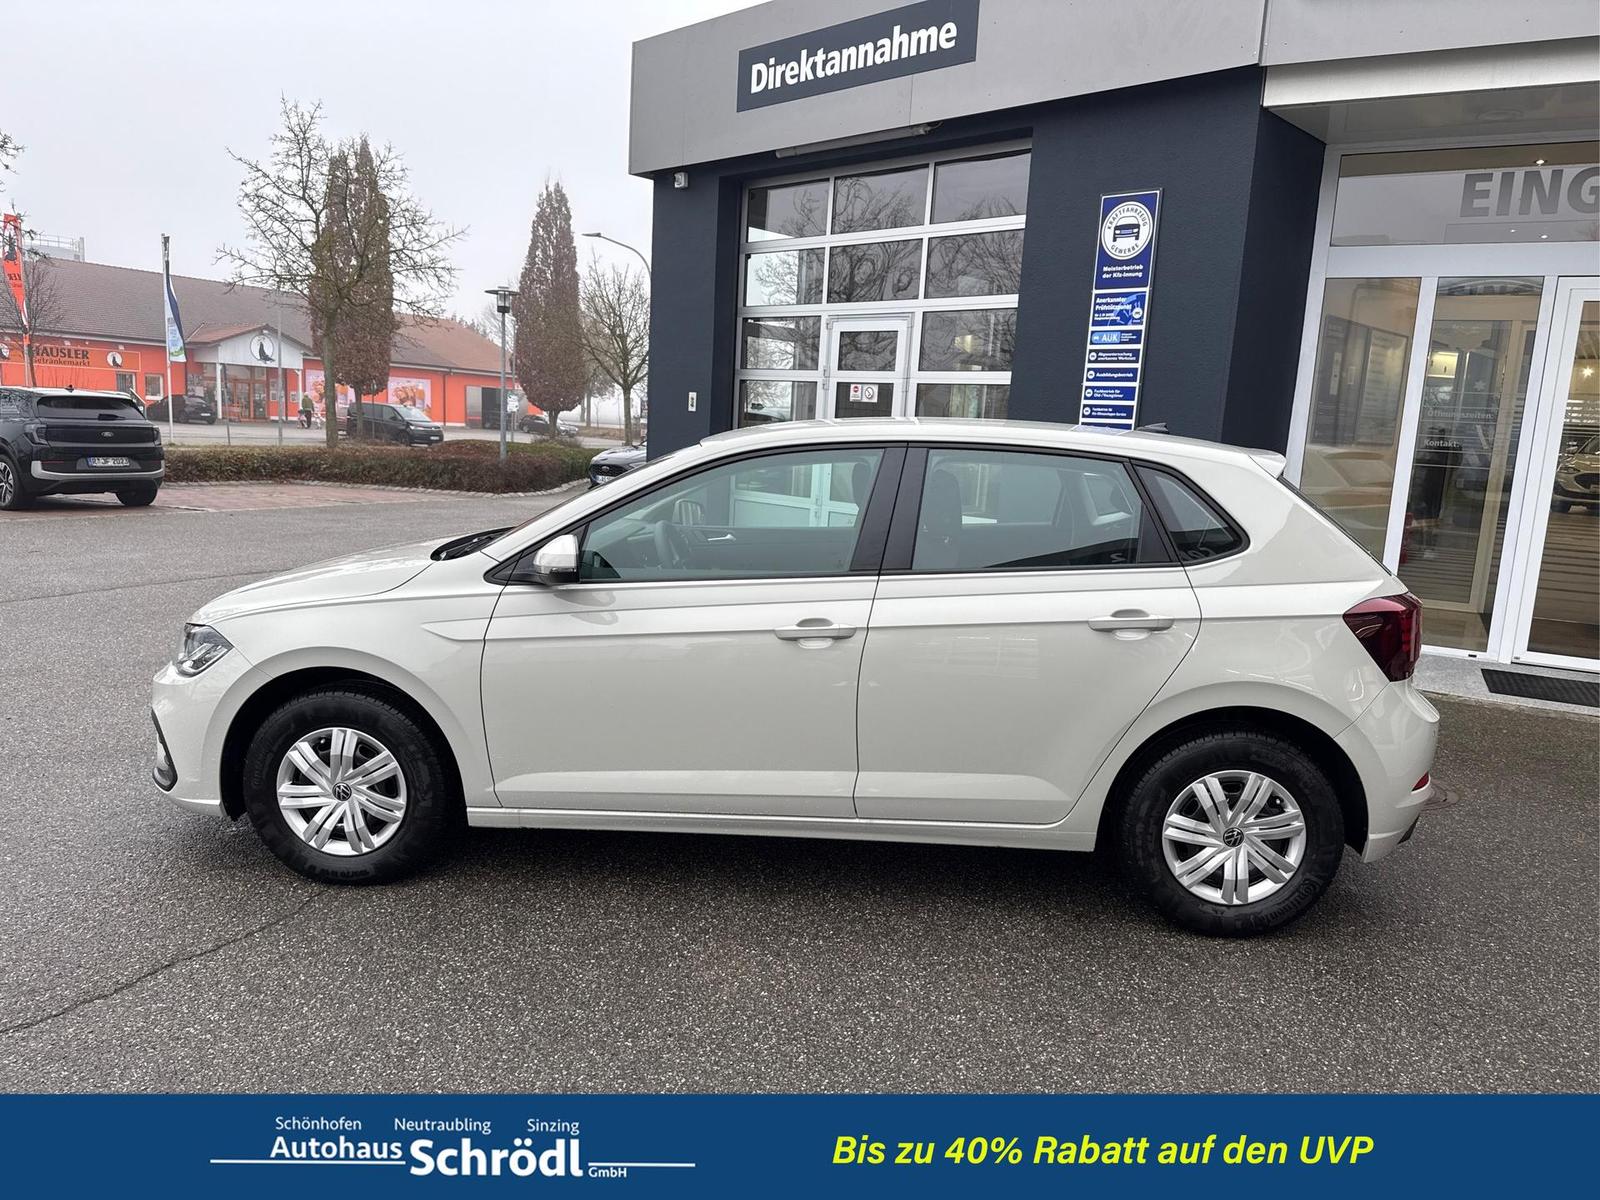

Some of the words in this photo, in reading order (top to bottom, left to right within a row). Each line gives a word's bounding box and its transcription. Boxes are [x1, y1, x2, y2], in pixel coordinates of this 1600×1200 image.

[750, 21, 958, 94] Direktannahme
[1460, 166, 1600, 217] EING
[1107, 207, 1148, 230] KRAFTFAHRZEUG
[1110, 243, 1140, 255] GEWERBE
[1103, 264, 1144, 272] Meisterbetrieb
